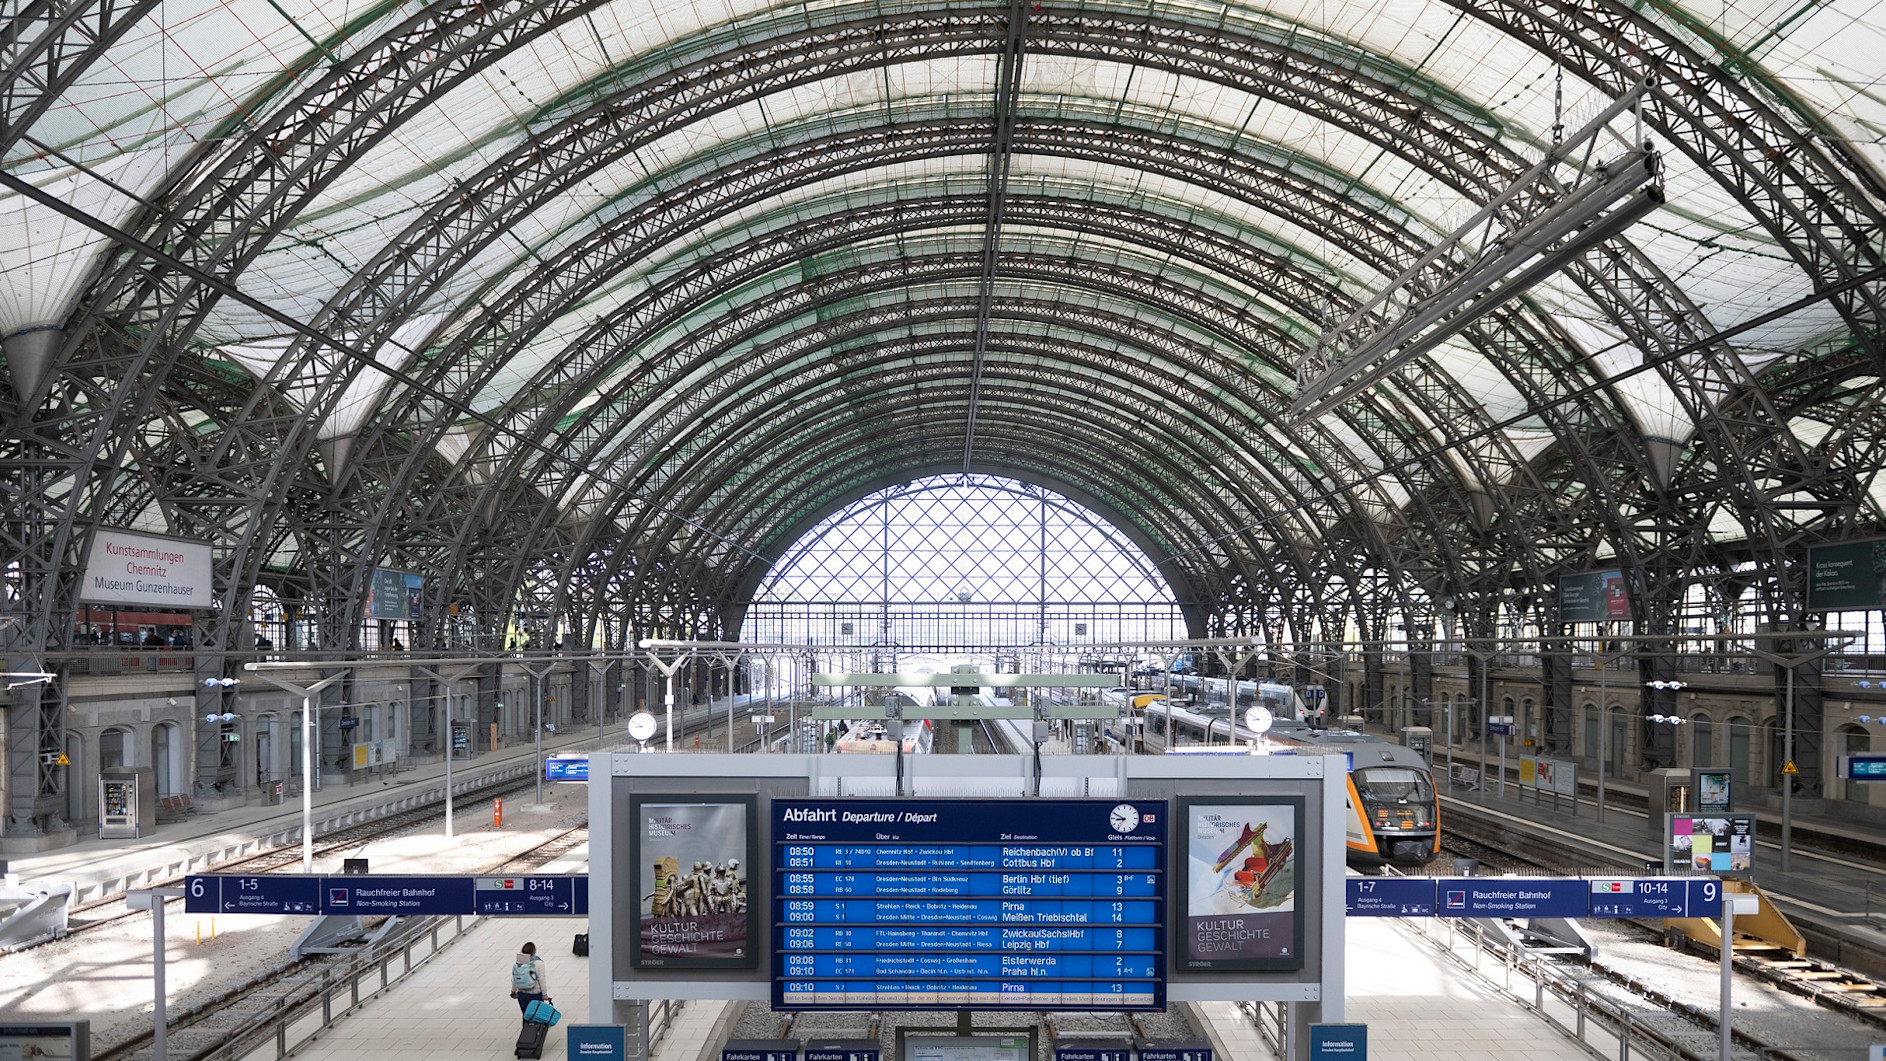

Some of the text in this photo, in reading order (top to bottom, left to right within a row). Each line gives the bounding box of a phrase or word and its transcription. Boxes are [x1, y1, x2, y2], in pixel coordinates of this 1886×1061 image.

[106, 542, 184, 564] Kunstsammlungen
[127, 562, 166, 577] Chemnitz
[95, 576, 193, 596] Museum Gunzenhauser
[783, 808, 937, 824] Abfahrt Departure Départ
[1003, 848, 1068, 856] Reichenbach(V)
[1071, 848, 1081, 856] ob
[1085, 848, 1094, 856] Bf
[1112, 848, 1122, 856] 11
[239, 879, 258, 890] 1-5
[495, 880, 502, 889] S
[529, 879, 554, 890] 8-14
[1003, 875, 1028, 883] Berlin
[1031, 875, 1046, 883] Hbf
[1048, 875, 1070, 883] (tief)
[1117, 875, 1122, 884] 3
[191, 878, 204, 897] 6
[1003, 886, 1031, 894] Görlitz
[1117, 886, 1122, 895] 9
[1358, 882, 1376, 892] 1-7
[1602, 883, 1610, 892] S
[1639, 883, 1668, 894] 10-14
[1703, 883, 1716, 902] 9
[650, 921, 698, 934] KULTUR
[1197, 919, 1244, 931] KULTUR
[652, 930, 723, 945] GESCHICHTE
[1003, 929, 1084, 938] Zwickau(Sachs)Hbf
[1117, 930, 1122, 938] 8
[1198, 929, 1270, 942] GESCHICHTE
[652, 943, 698, 954] GEWALT
[1003, 941, 1031, 950] Leipzig
[1198, 941, 1244, 952] GEWALT
